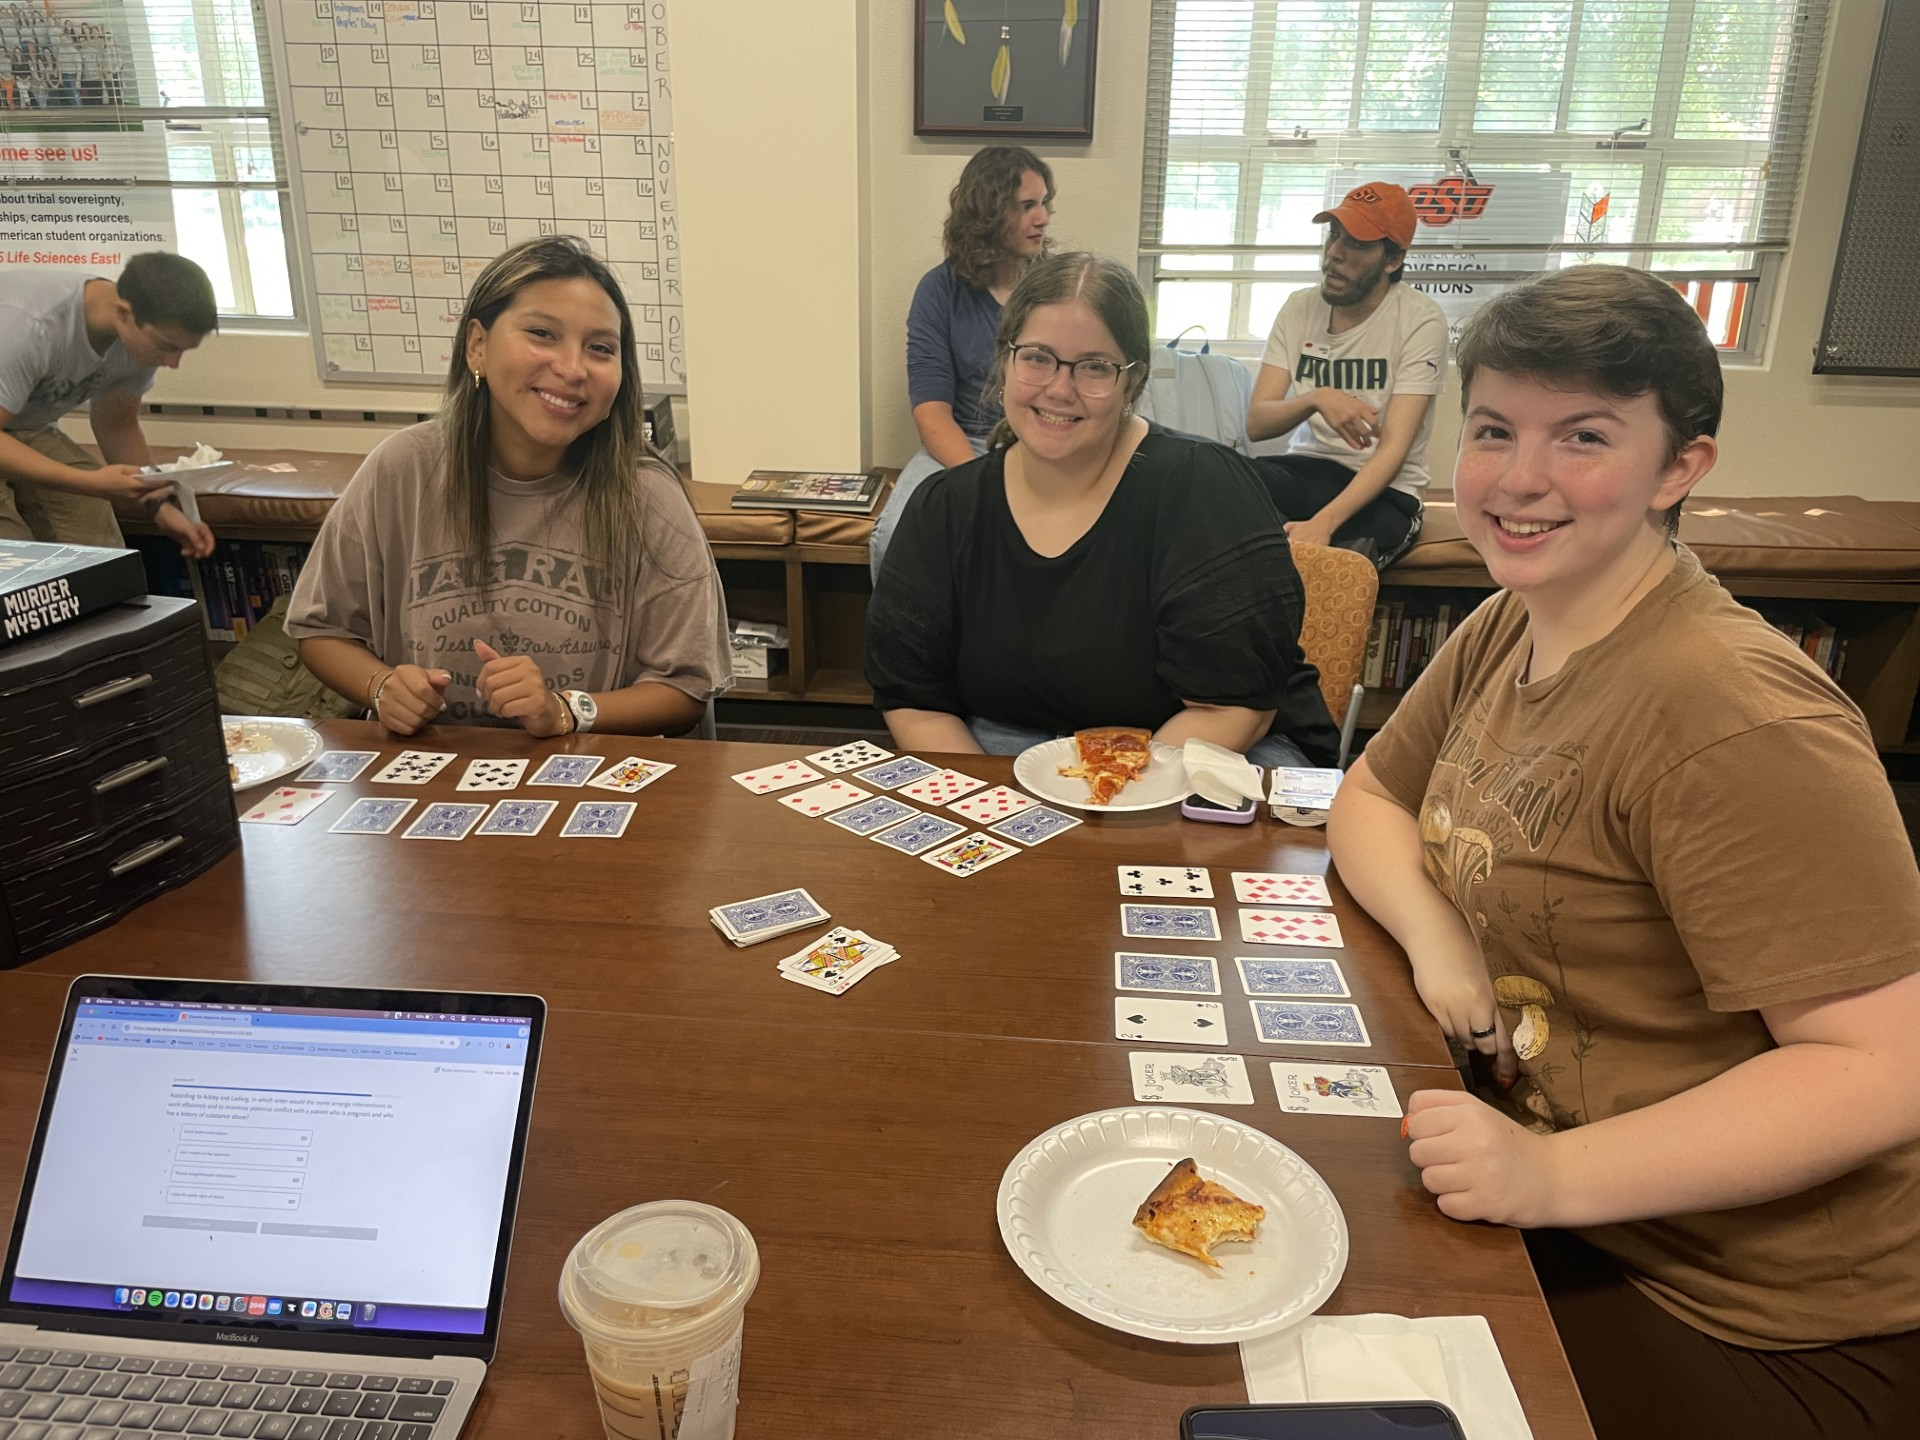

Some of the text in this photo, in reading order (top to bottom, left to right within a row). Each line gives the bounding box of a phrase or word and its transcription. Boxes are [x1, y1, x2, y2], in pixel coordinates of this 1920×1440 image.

[319, 3, 330, 14] 13
[422, 4, 434, 14] 15
[473, 4, 484, 15] 16
[523, 6, 534, 18] 17
[578, 7, 589, 19] 18
[630, 7, 640, 20] 19
[324, 47, 335, 59] 20
[375, 48, 385, 60] 21
[425, 49, 438, 60] 22
[477, 49, 490, 61] 23
[528, 50, 541, 62] 24
[580, 53, 593, 64] 25
[631, 55, 645, 65] 26
[327, 91, 339, 103] 27
[377, 93, 390, 103] 28
[428, 94, 441, 104] 29
[480, 94, 494, 106] 30
[530, 95, 543, 106] 31
[638, 96, 647, 106] 2
[335, 133, 344, 144] 3
[384, 133, 393, 145] 4
[433, 135, 443, 146] 5
[485, 135, 495, 146] 6
[534, 137, 543, 148] 7
[588, 137, 596, 149] 8
[637, 139, 646, 152] 9
[34, 146, 66, 162] see
[72, 144, 99, 162] us!
[340, 175, 350, 186] 10
[387, 176, 396, 188] 11
[437, 178, 451, 188] 12
[488, 179, 501, 190] 13
[589, 180, 602, 192] 15
[640, 182, 652, 194] 16
[28, 193, 55, 205] tribal
[58, 194, 125, 207] sovereignty,
[1408, 176, 1496, 228] OSU
[31, 214, 74, 225] campus
[76, 214, 133, 225] resources,
[344, 217, 354, 228] 17
[392, 218, 404, 230] 18
[443, 220, 454, 230] 19
[490, 221, 503, 231] 20
[541, 223, 553, 235] 21
[591, 223, 604, 234] 22
[641, 225, 655, 236] 23
[45, 231, 86, 241] student
[89, 231, 166, 244] organizations.
[8, 251, 121, 265] Life Sciences East!
[397, 260, 410, 270] 25
[445, 261, 458, 271] 26
[644, 267, 657, 278] 30
[404, 301, 413, 311] 2
[452, 302, 462, 312] 3
[648, 308, 655, 318] 7
[359, 337, 368, 348] 8
[407, 339, 415, 350] 9
[1295, 353, 1387, 390] PUMA
[4, 577, 72, 617] MURDER
[4, 595, 81, 640] MYSTERY
[431, 597, 592, 633] QUALITY COTTON
[1144, 1063, 1164, 1092] JOKER
[1287, 1074, 1310, 1104] JOKER
[170, 1092, 195, 1101] According
[203, 1094, 219, 1102] Ackley
[353, 1101, 386, 1109] interventions
[182, 1102, 206, 1110] effectively
[249, 1301, 265, 1309] 2048
[216, 1332, 260, 1343] MacBook Air
[413, 1410, 434, 1418] delete
